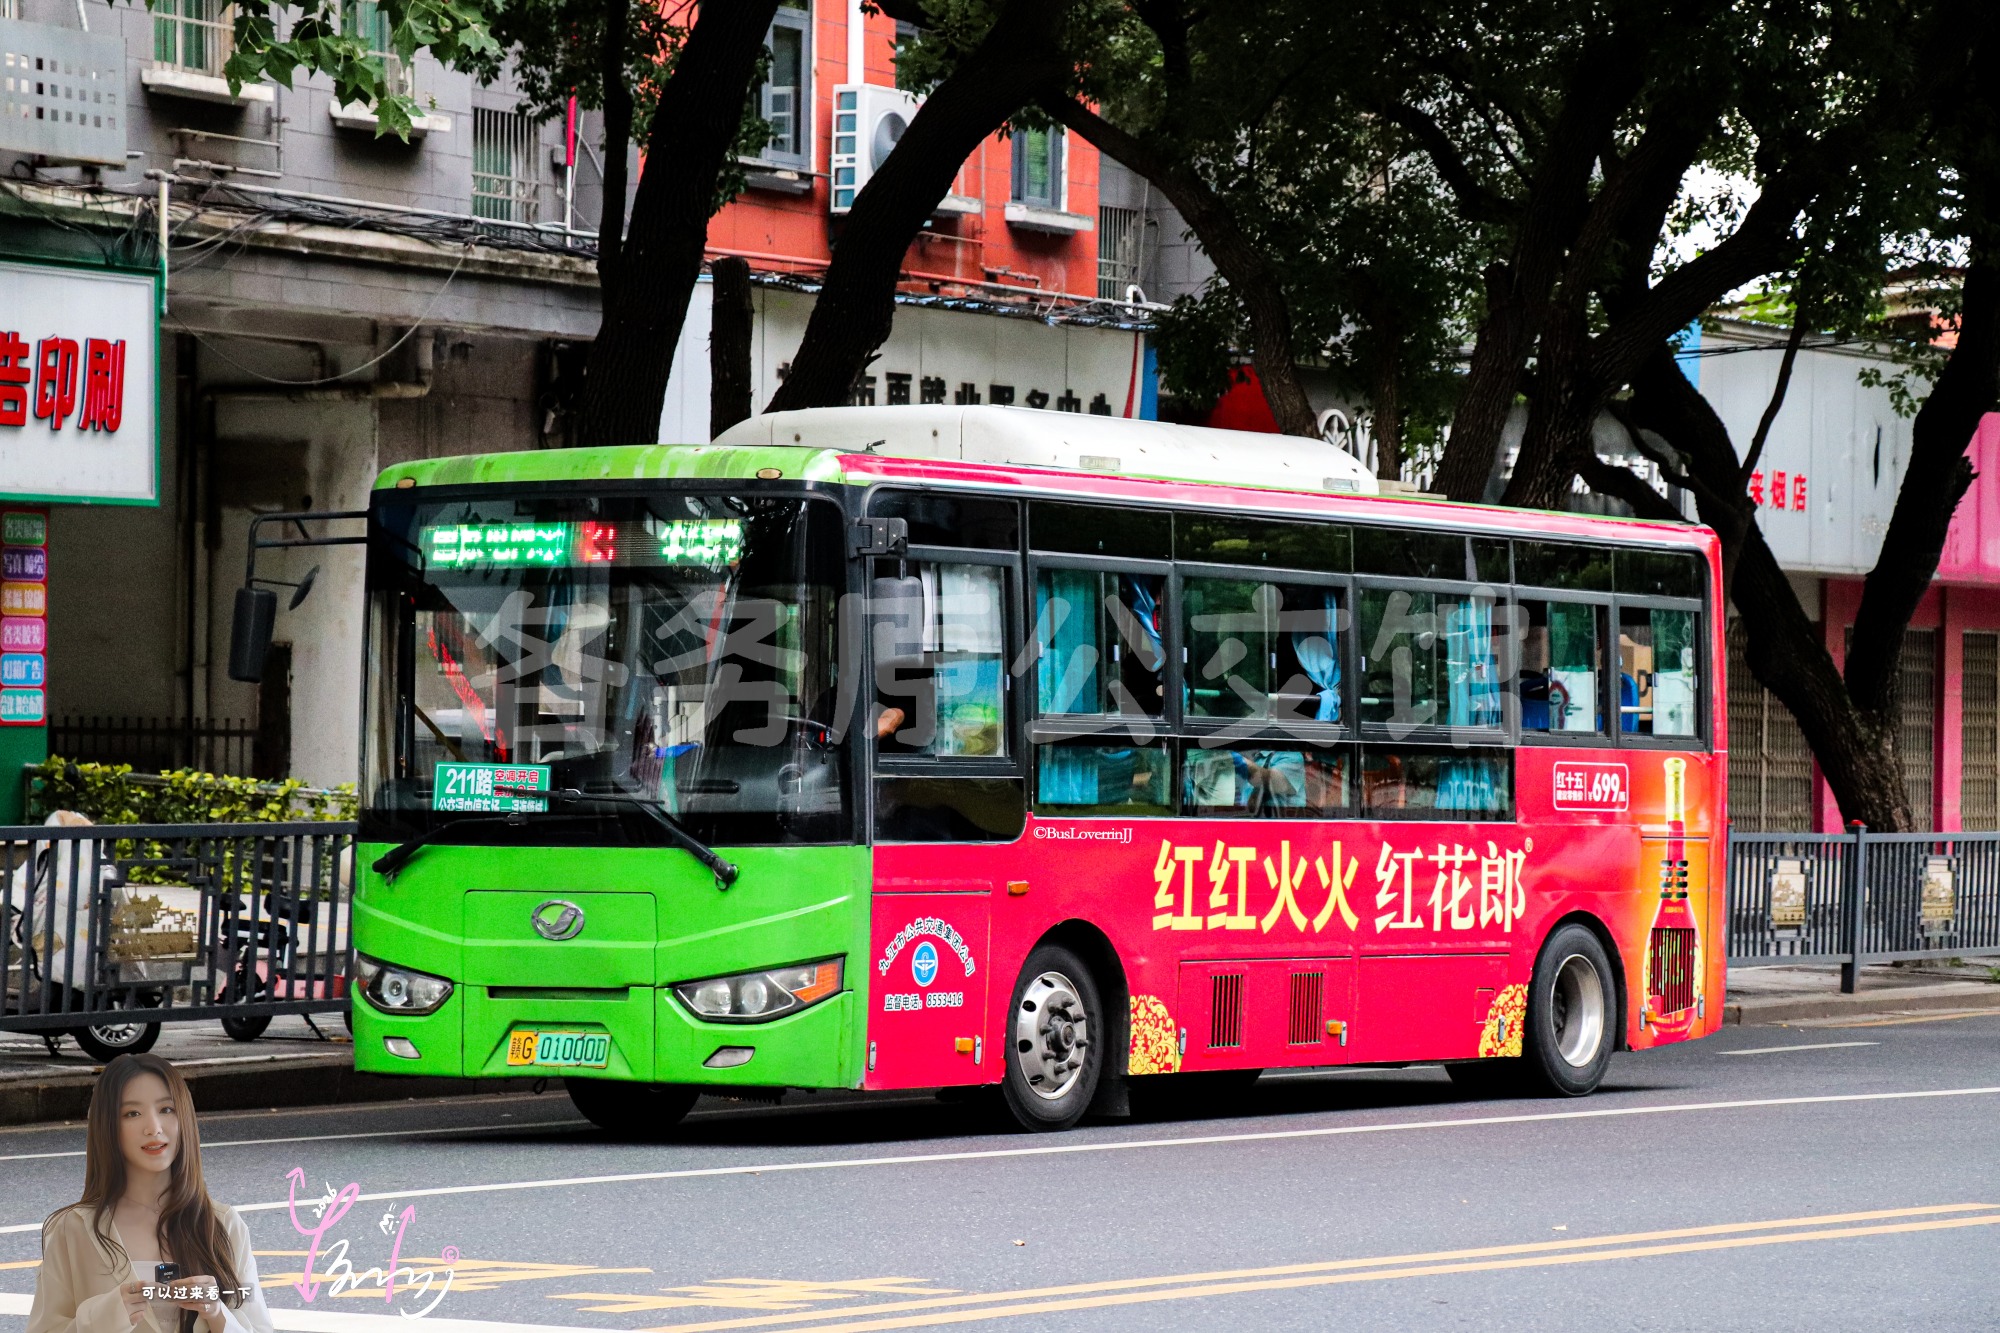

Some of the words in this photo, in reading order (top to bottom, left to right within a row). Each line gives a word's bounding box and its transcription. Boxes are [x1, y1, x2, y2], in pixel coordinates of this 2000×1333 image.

[445, 768, 493, 796] 211路
[494, 769, 539, 783] 空调开启
[1556, 771, 1584, 789] 红十五
[1152, 838, 1360, 935] 红红火火
[1374, 840, 1527, 935] 红花郎
[878, 916, 976, 977] 九江市公共交通集团公司
[926, 992, 963, 1007] 8553416
